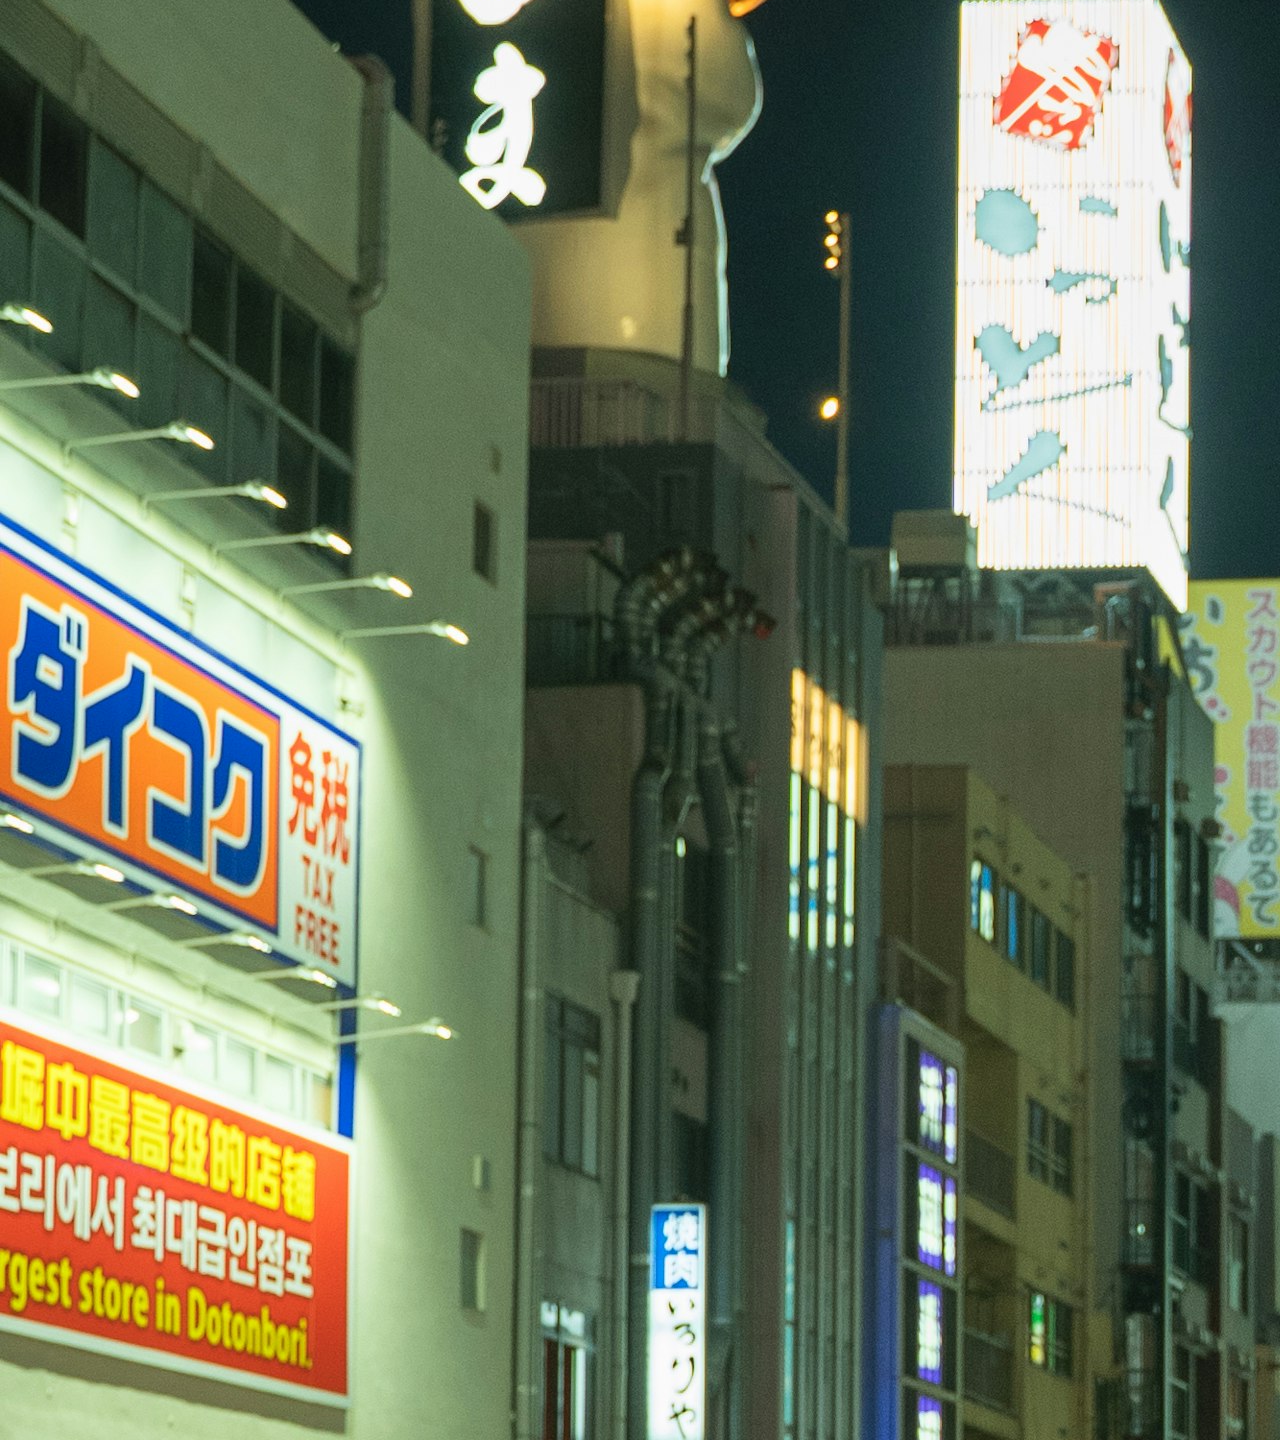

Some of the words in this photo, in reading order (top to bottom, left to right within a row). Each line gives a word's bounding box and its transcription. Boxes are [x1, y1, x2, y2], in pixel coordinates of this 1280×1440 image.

[10, 598, 264, 895] ダイコク
[288, 730, 350, 865] 免税
[302, 854, 336, 912] TAX
[294, 904, 342, 967] FREE
[131, 1184, 314, 1298] 최대급인점포
[663, 1212, 699, 1289] 焼肉
[78, 1266, 150, 1329] store
[155, 1275, 182, 1336] in
[187, 1286, 313, 1370] Dotonbori.
